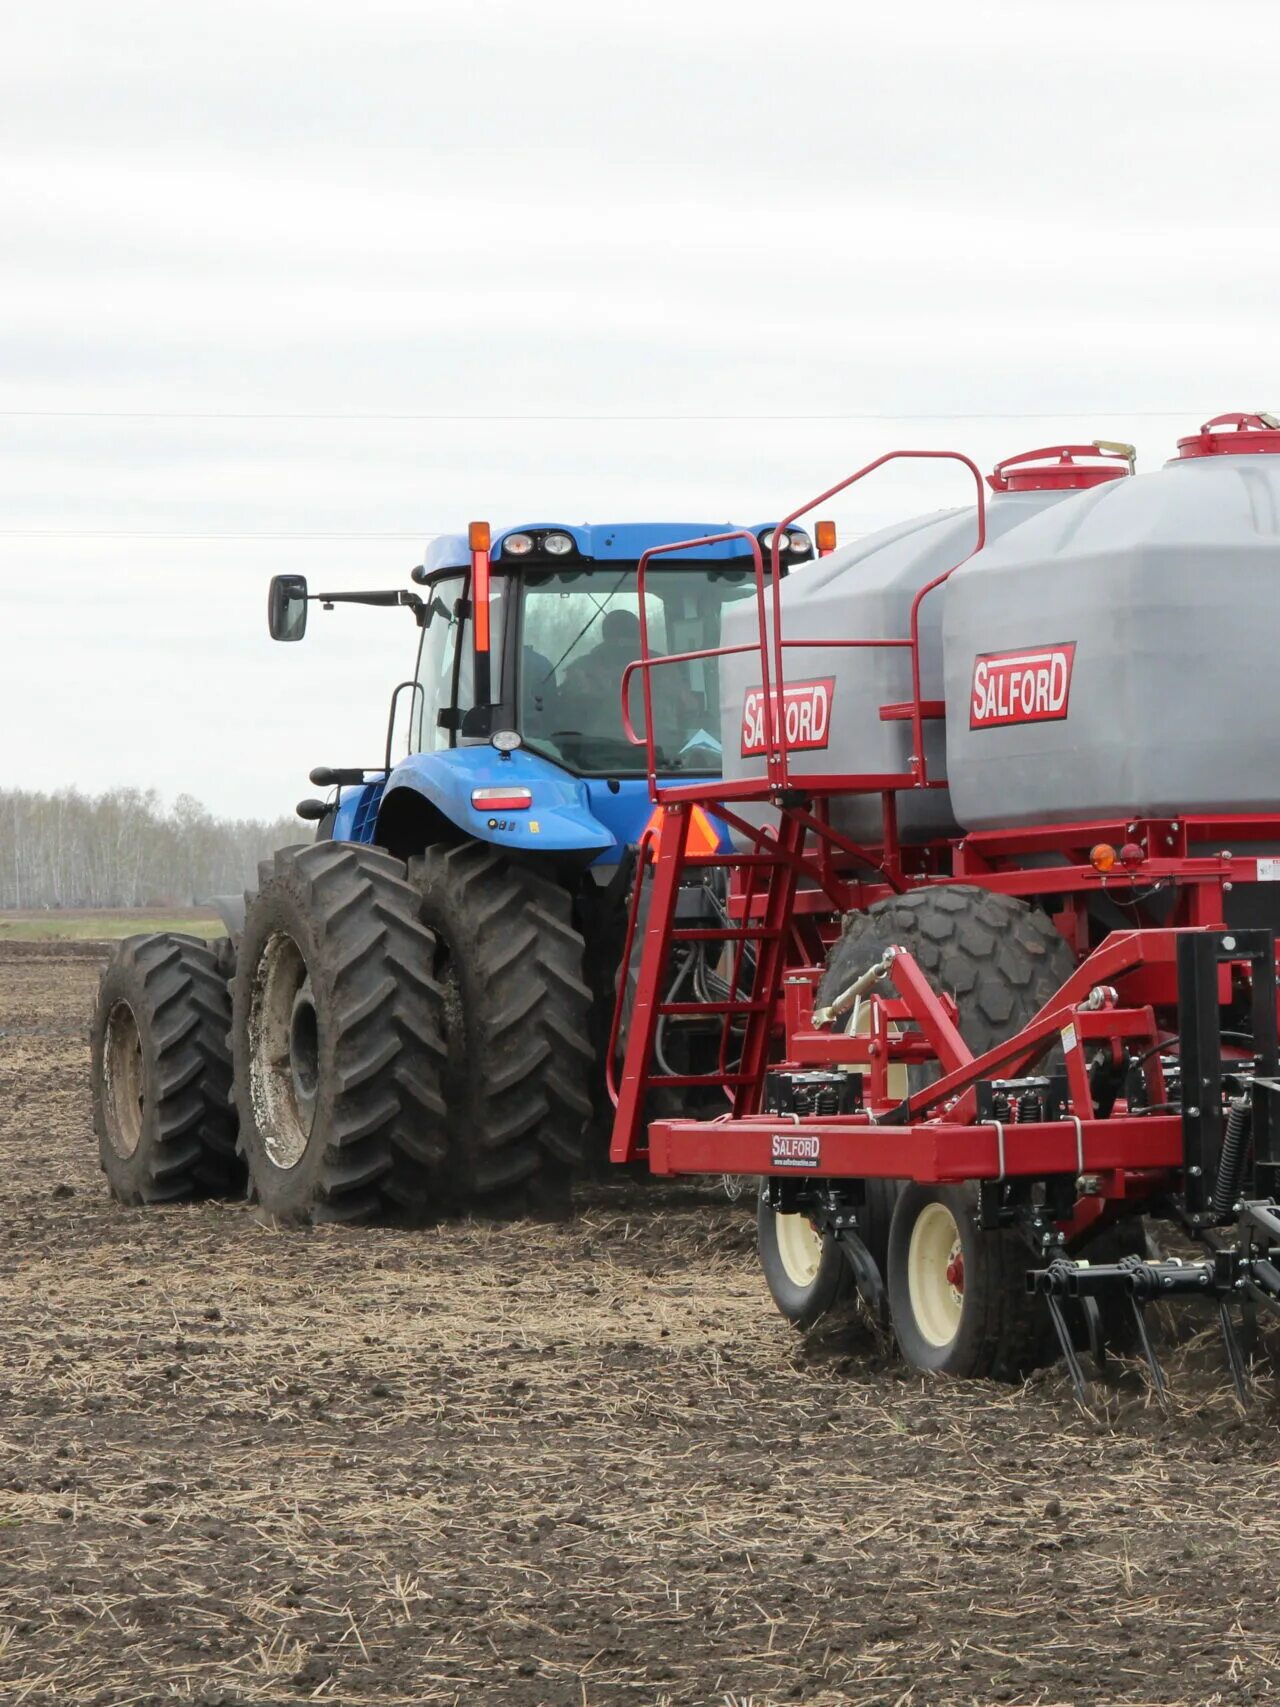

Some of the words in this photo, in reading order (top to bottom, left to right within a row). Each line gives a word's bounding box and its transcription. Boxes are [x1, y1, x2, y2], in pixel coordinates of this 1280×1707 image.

[743, 686, 827, 749] SAORD
[973, 653, 1067, 720] SALFORD
[772, 1135, 820, 1157] SALFORD
